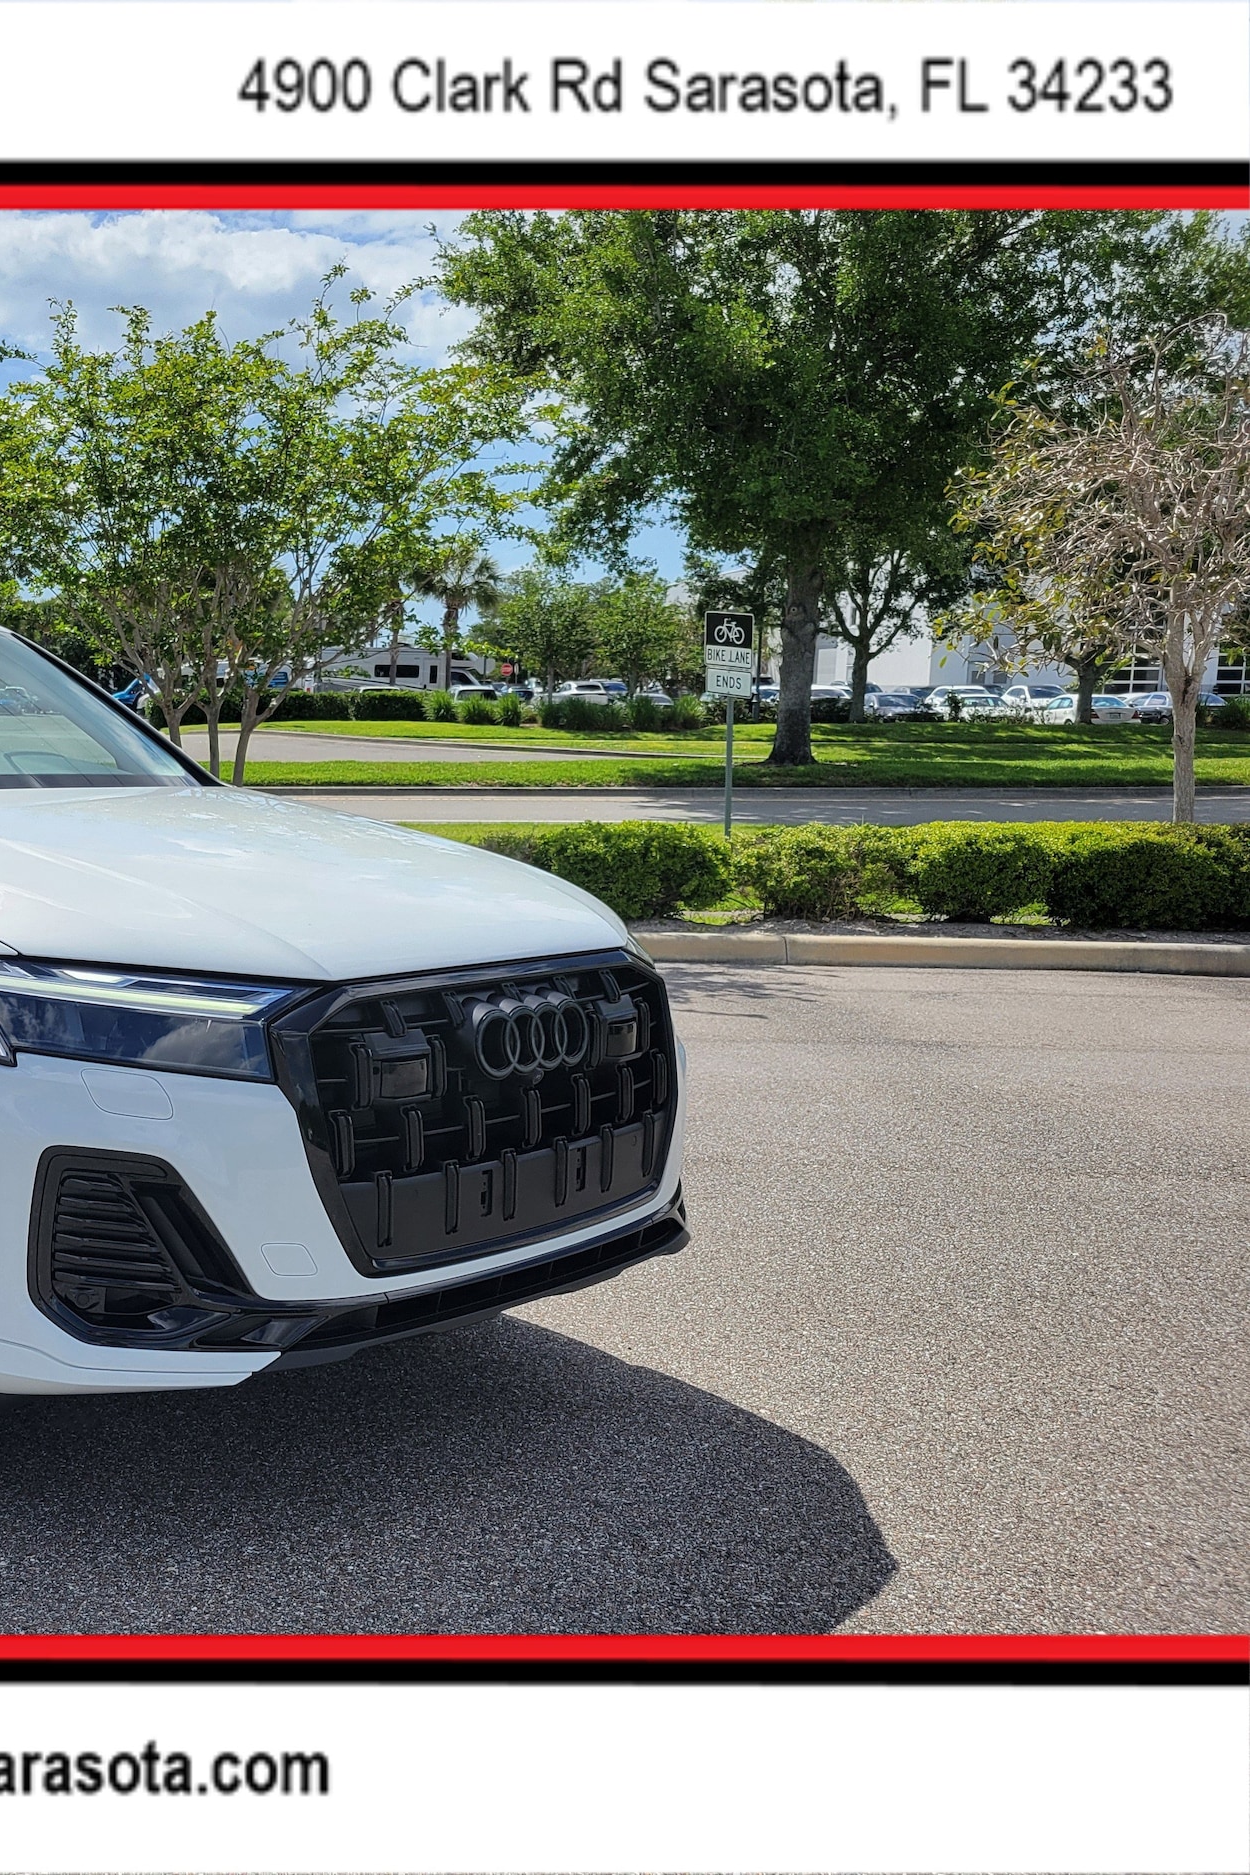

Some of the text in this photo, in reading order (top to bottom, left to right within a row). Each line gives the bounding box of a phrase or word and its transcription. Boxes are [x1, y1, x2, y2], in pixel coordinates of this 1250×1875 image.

[707, 648, 750, 665] BIKE LANE
[716, 675, 742, 690] ENDS
